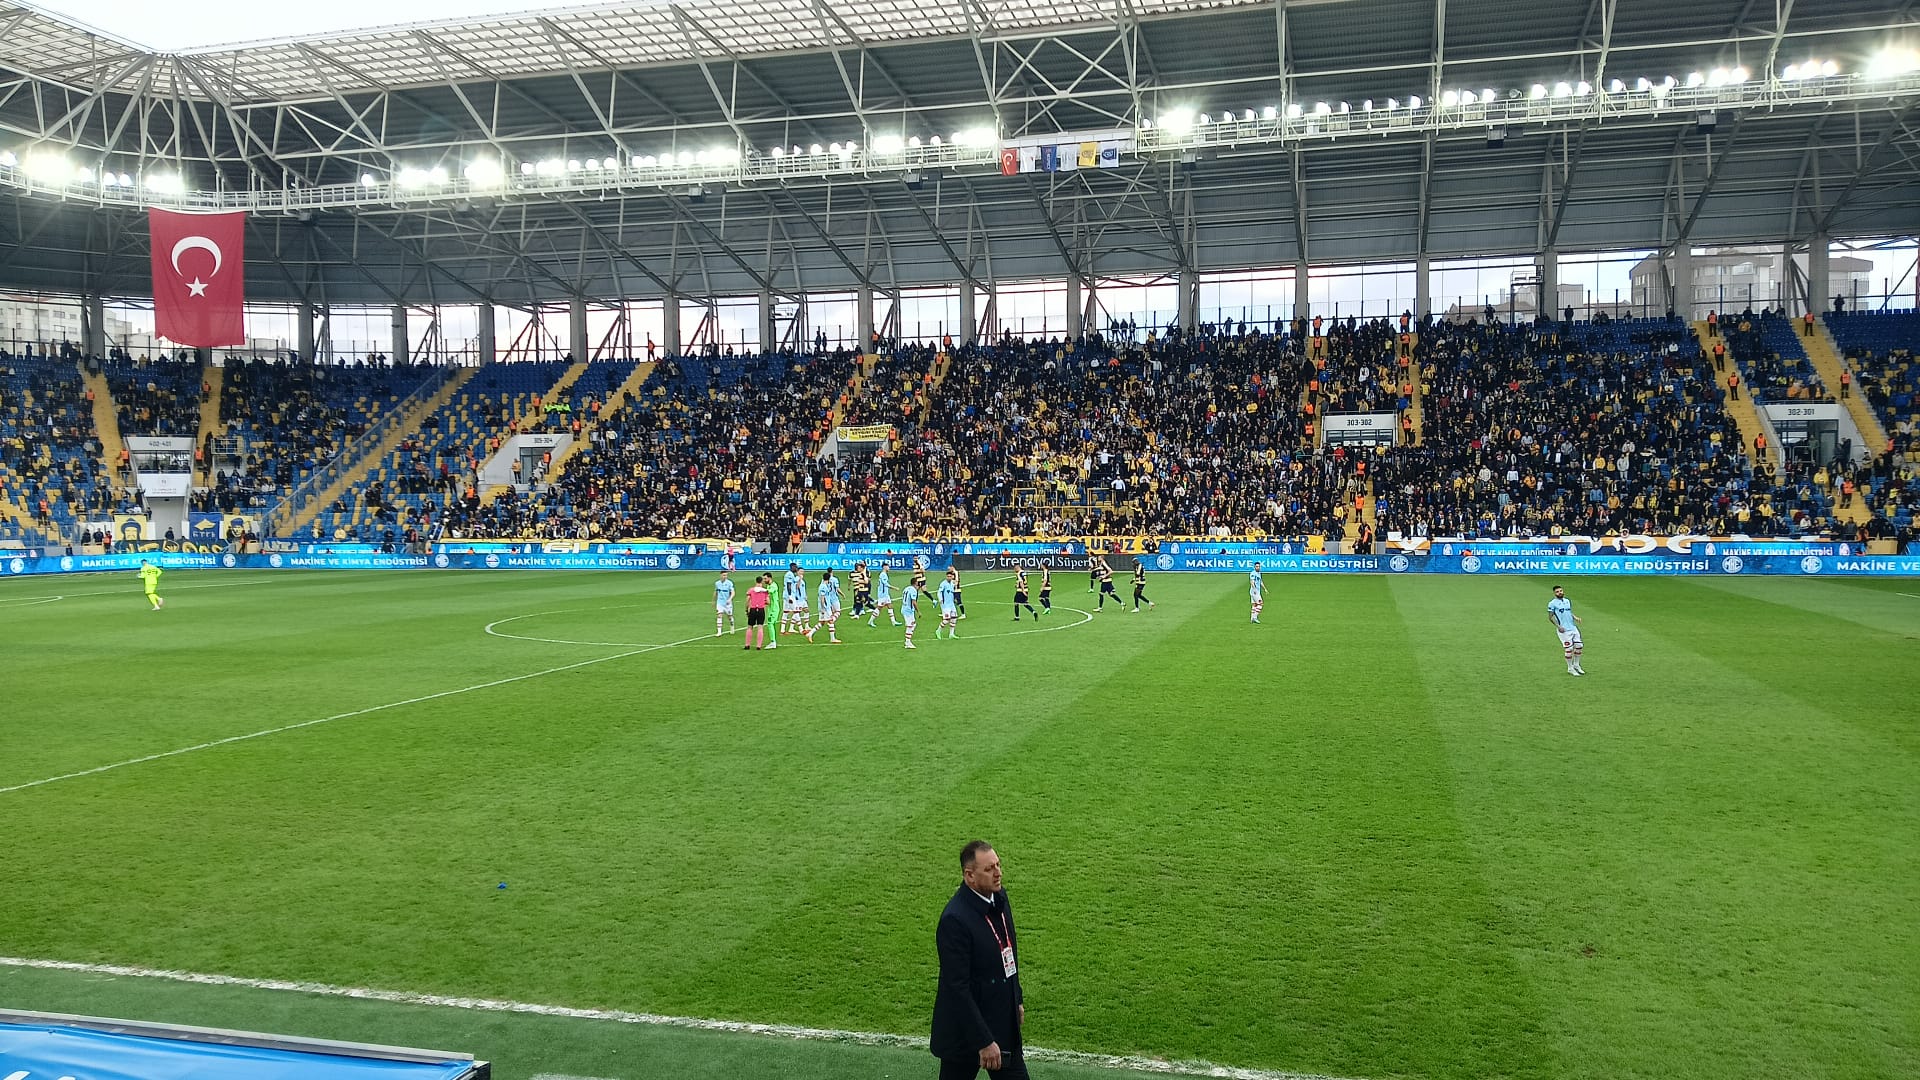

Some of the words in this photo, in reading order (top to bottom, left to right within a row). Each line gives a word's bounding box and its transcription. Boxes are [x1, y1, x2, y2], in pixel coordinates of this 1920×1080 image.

[291, 556, 325, 566] MAKİNE
[328, 558, 340, 566] VE
[373, 556, 428, 566] ENDÜSTRİSİ
[508, 556, 546, 566] MAKİNE
[550, 558, 562, 566] VE
[565, 556, 596, 566] KİMYA
[599, 556, 658, 567] ENDÜSTRİSİ
[745, 556, 786, 567] MAKİNE
[805, 556, 839, 567] KİMYA
[1000, 556, 1055, 569] trendyol
[1186, 558, 1235, 568] MAKİNE
[1239, 560, 1252, 568] VE
[1259, 557, 1298, 568] KİMYA
[1302, 557, 1378, 569] ENDÜSTRİSİ
[1495, 559, 1548, 570] MAKİNE
[1553, 562, 1571, 570] VE
[1575, 559, 1620, 570] KİMYA
[1624, 559, 1709, 571] ENDÜSTRİSİ
[1837, 560, 1896, 571] MAKİNE
[1901, 562, 1920, 571] VE
